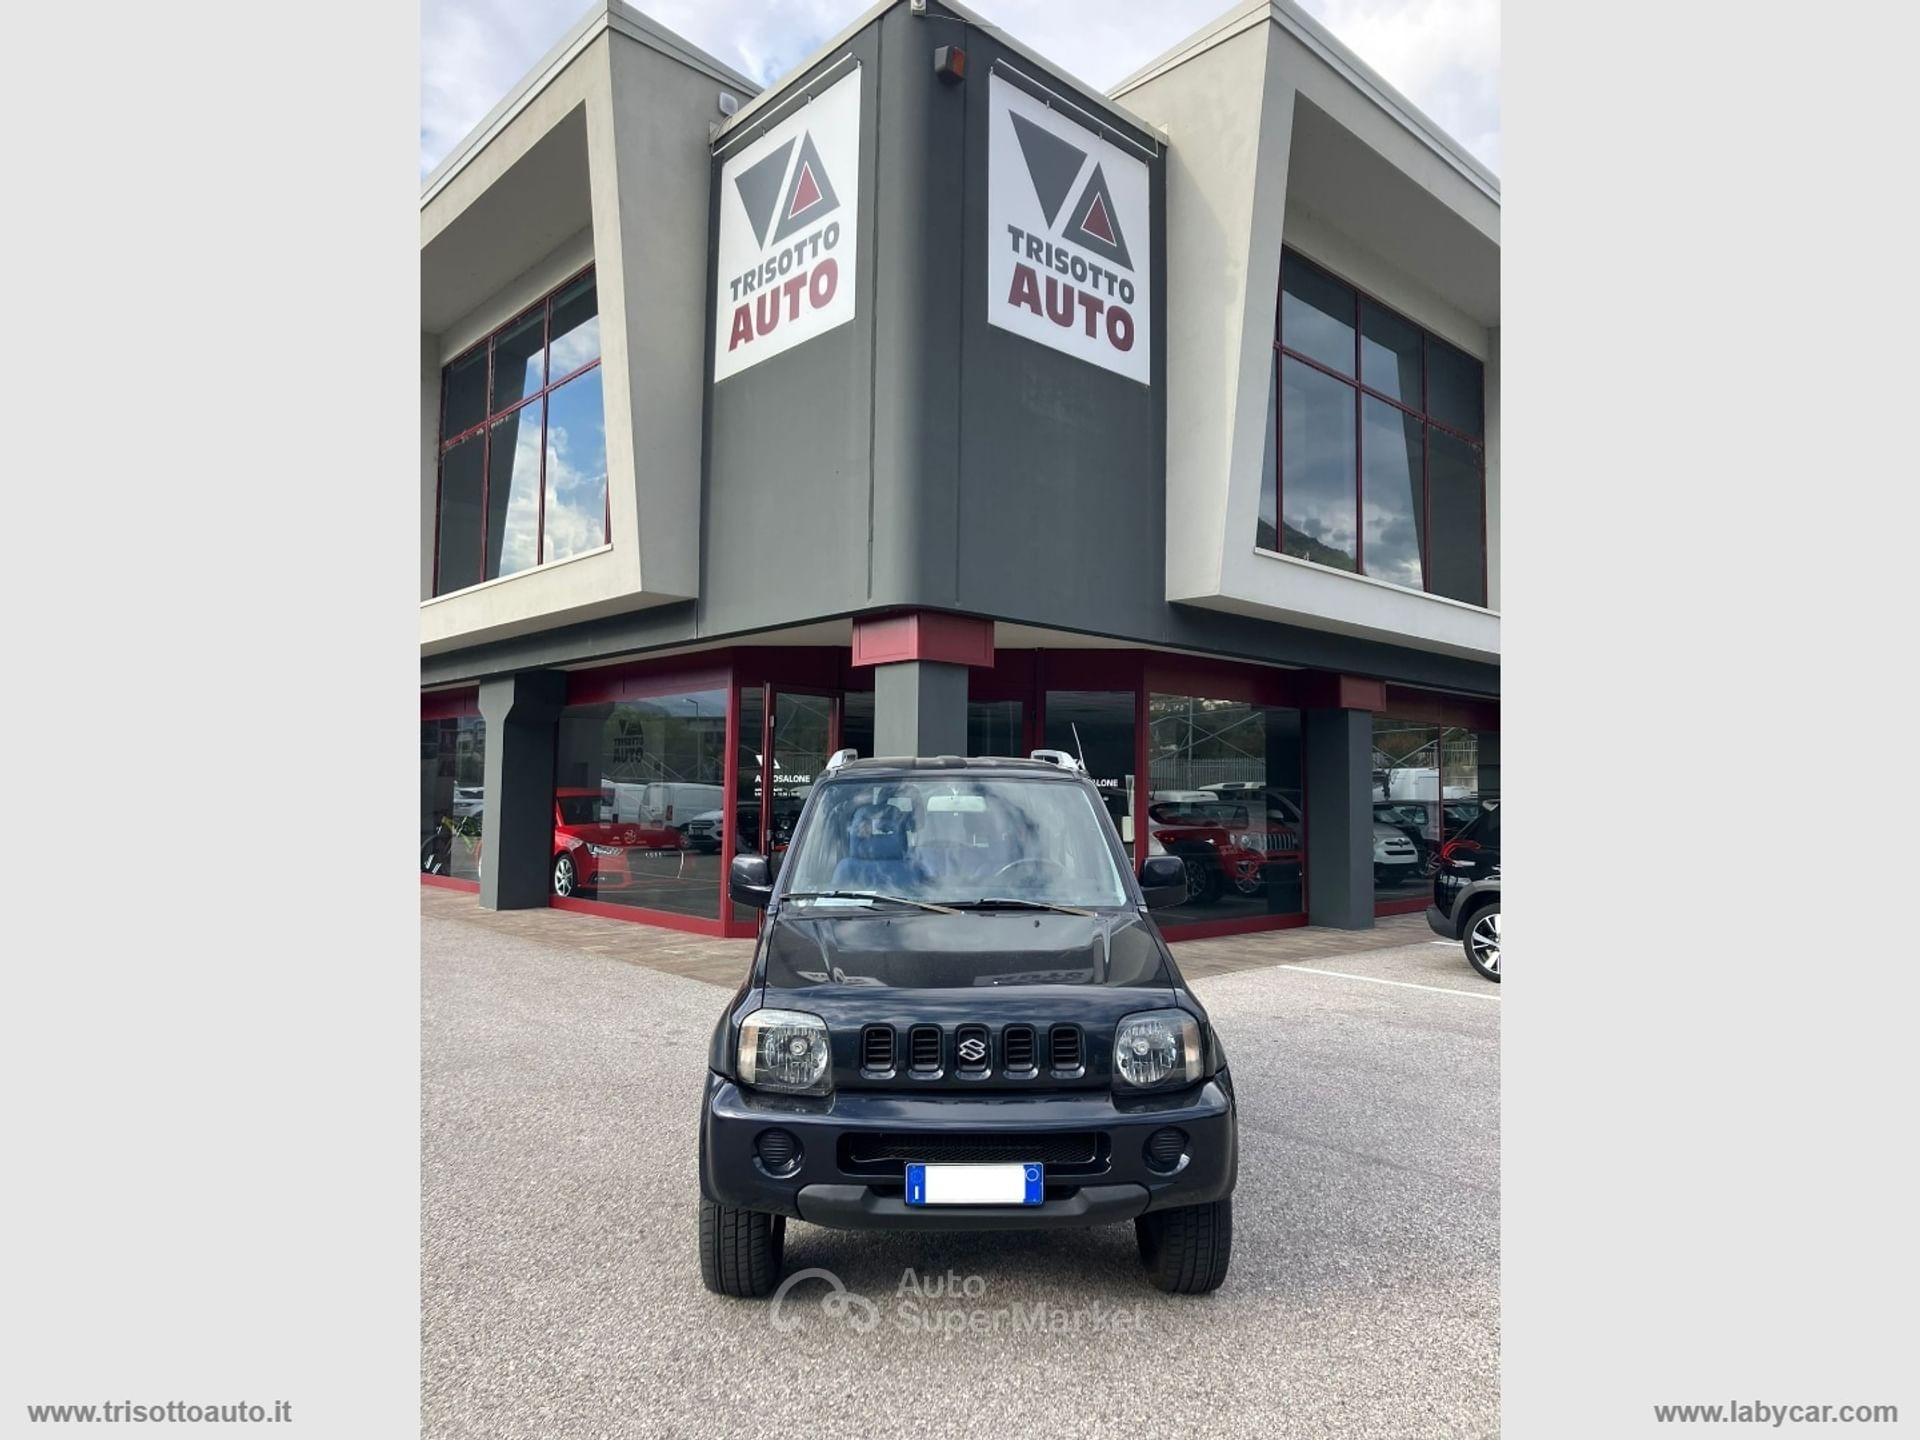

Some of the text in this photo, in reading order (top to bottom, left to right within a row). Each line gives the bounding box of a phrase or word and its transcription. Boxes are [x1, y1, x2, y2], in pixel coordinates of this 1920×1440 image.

[730, 221, 840, 302] TRISOTTO
[1007, 223, 1135, 305] TRISOTTO
[728, 257, 839, 352] AUTO
[1008, 261, 1135, 352] AUTO
[754, 774, 811, 783] AOSALONE
